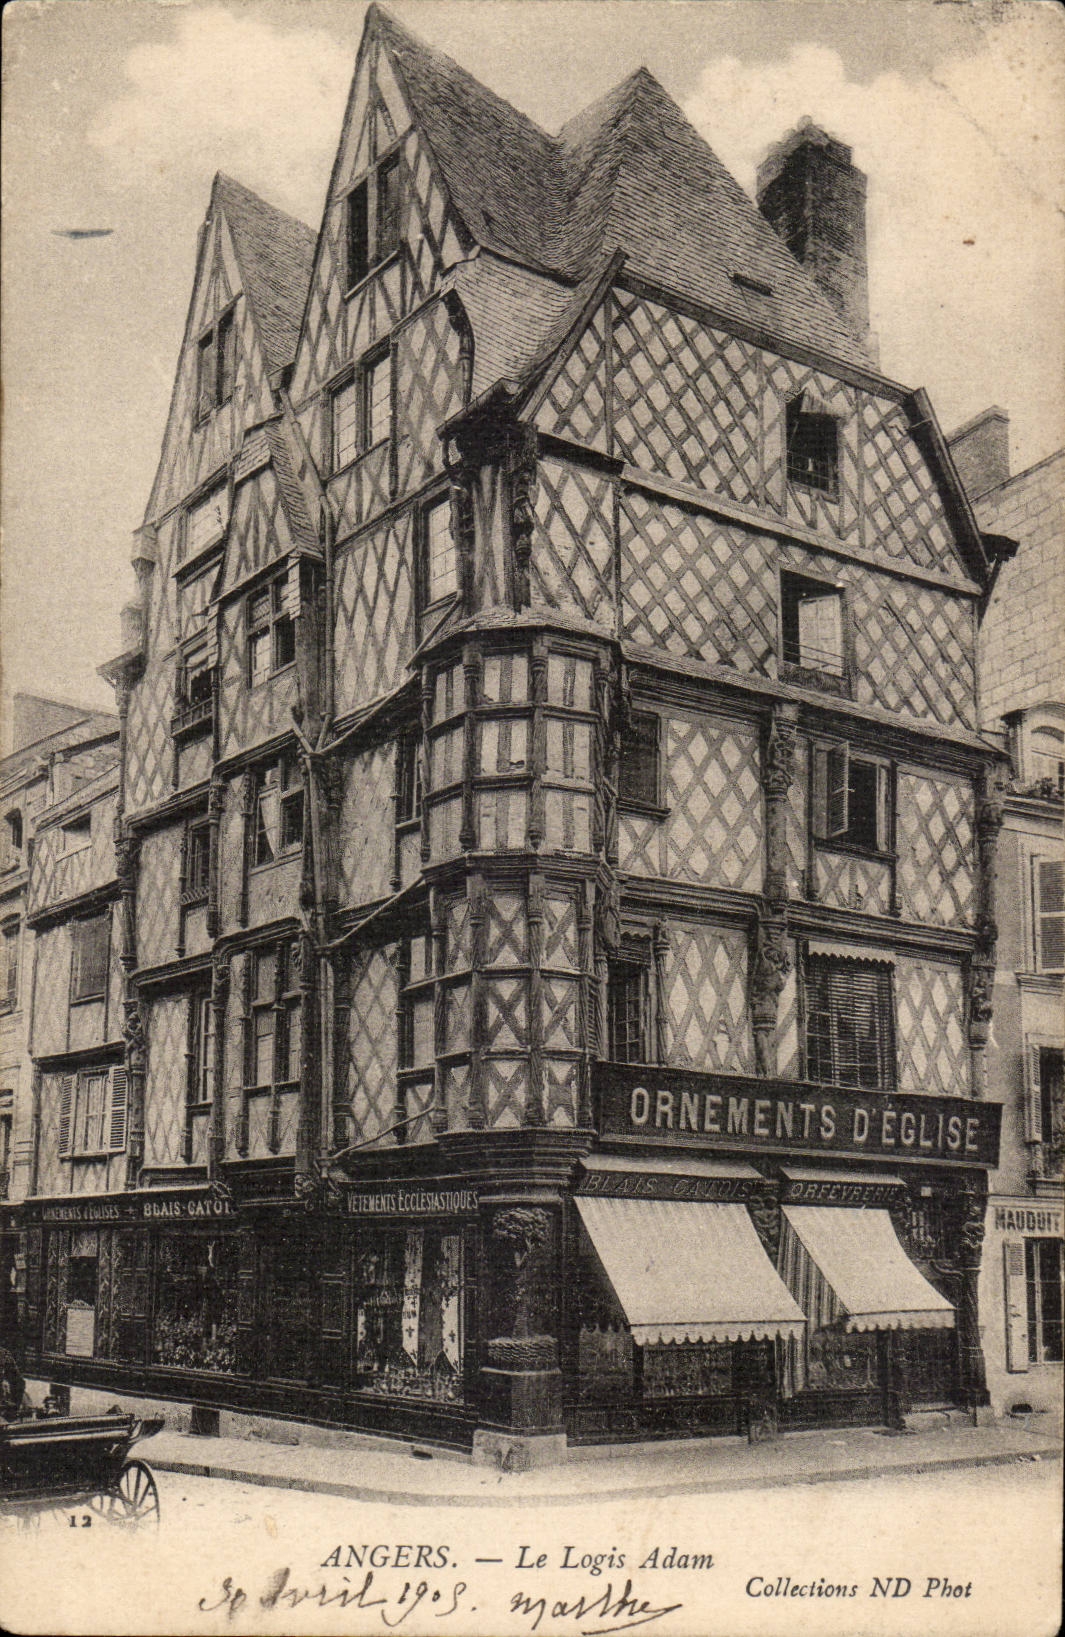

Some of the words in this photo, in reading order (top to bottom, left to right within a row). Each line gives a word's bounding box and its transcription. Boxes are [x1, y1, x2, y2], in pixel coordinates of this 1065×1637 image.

[630, 1087, 836, 1140] ORNEMENTS
[583, 1175, 657, 1195] BLAIS
[994, 1207, 1062, 1232] MAUDUIT
